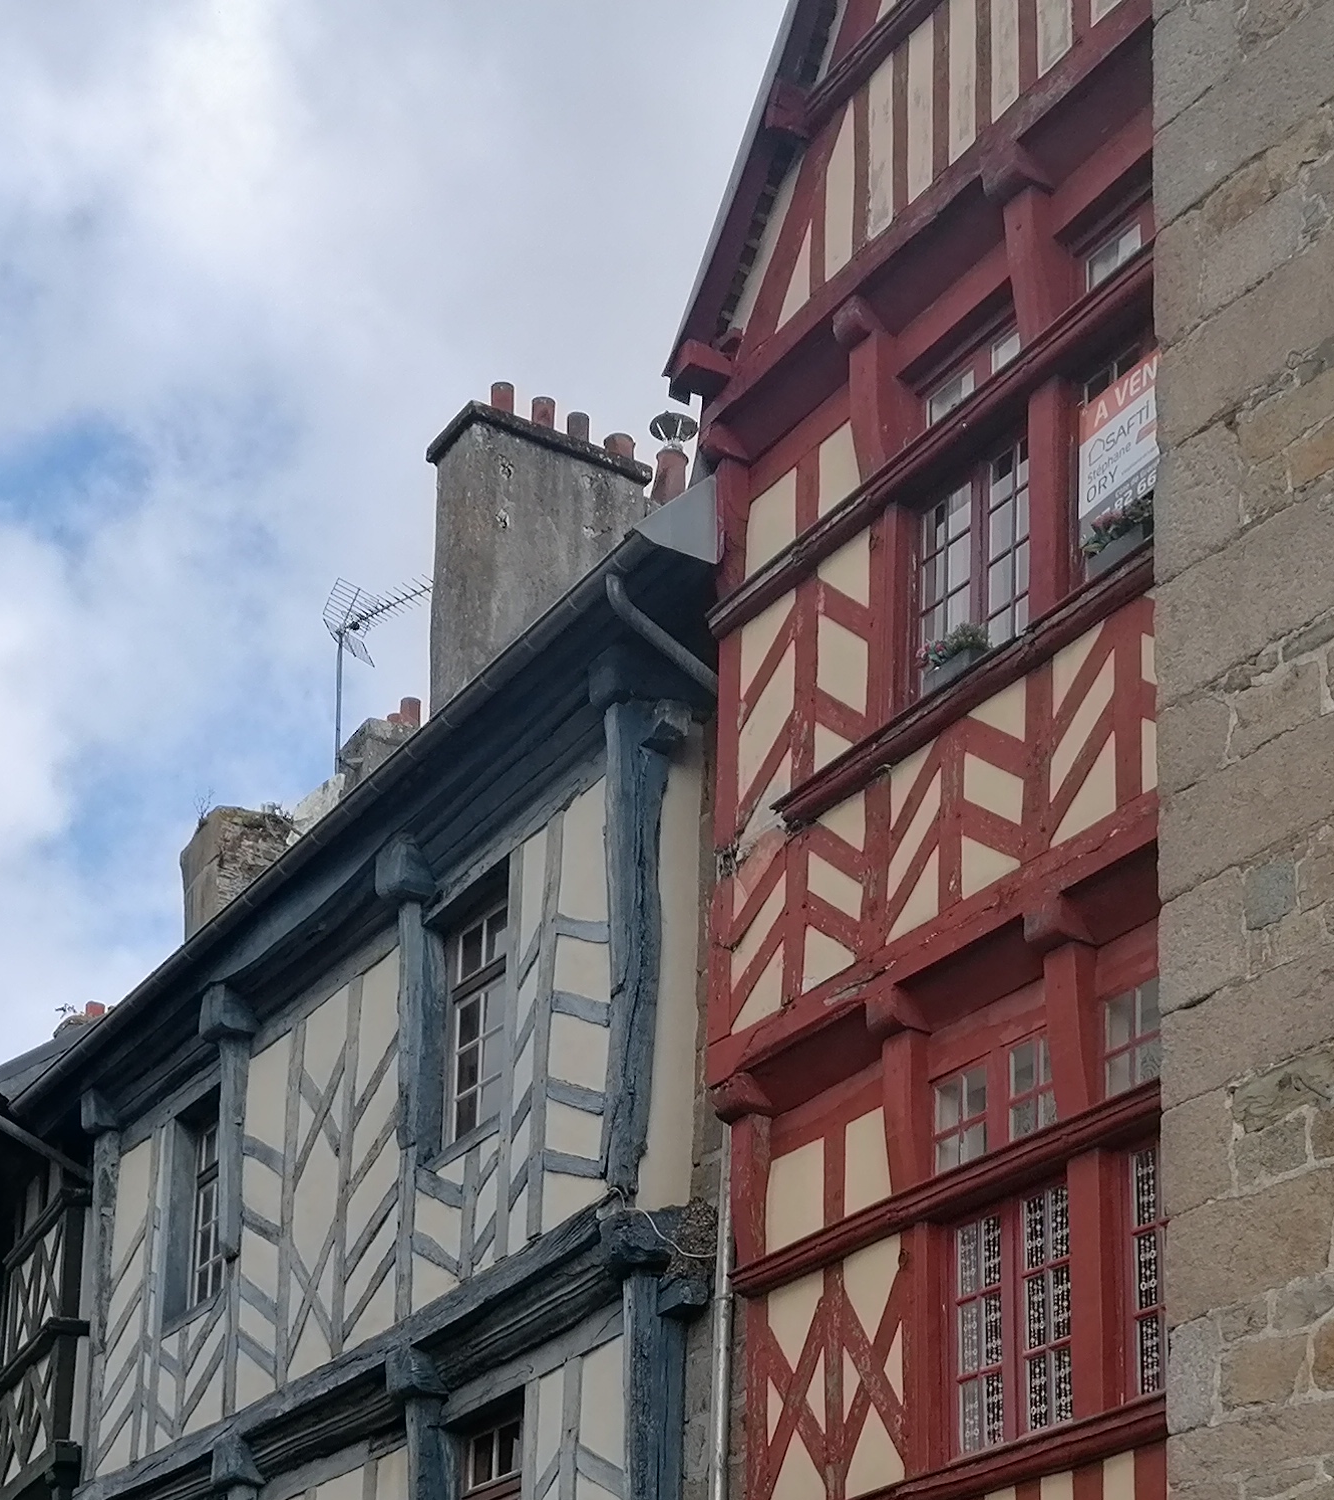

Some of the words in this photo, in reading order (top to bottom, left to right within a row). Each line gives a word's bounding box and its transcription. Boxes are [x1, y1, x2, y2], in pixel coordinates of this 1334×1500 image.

[1094, 399, 1108, 428] A
[1114, 352, 1162, 407] VEN
[1087, 442, 1132, 485] Stéphane
[1087, 465, 1118, 503] ORY
